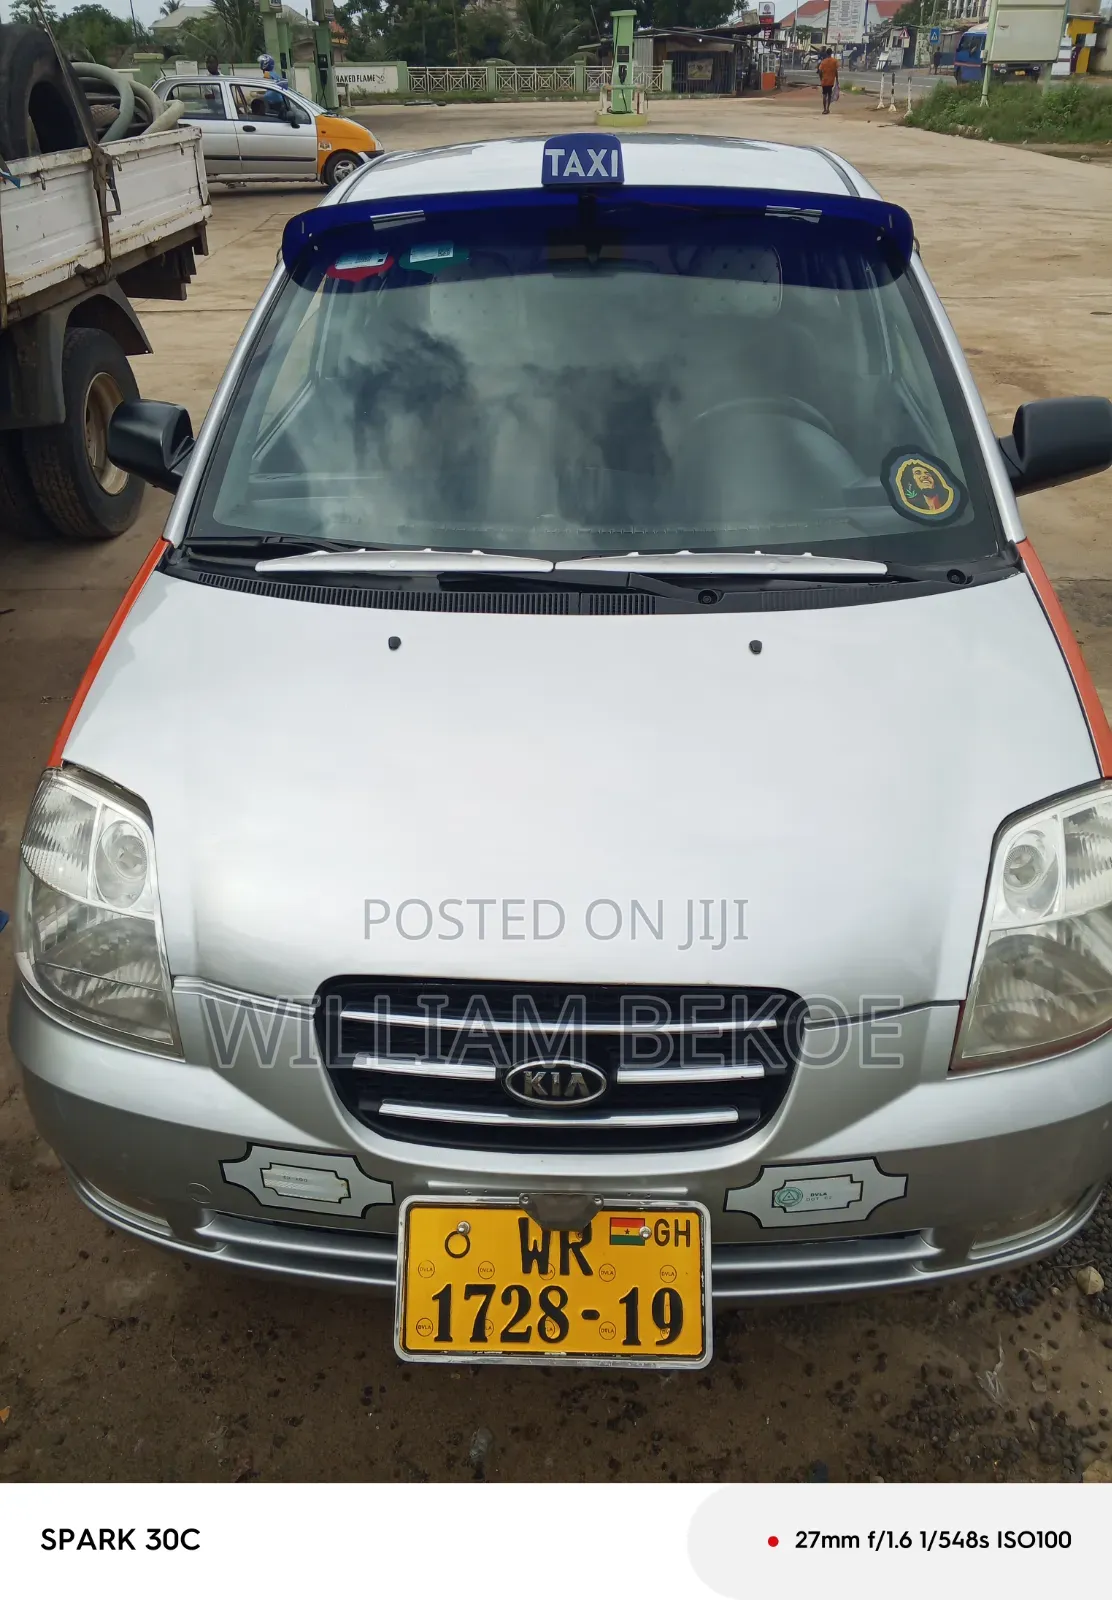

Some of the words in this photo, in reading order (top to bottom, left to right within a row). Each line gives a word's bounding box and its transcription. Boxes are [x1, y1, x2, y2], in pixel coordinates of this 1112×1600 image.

[357, 74, 375, 82] FLAME
[544, 148, 619, 178] TAXI
[522, 1070, 591, 1097] KIA
[518, 1216, 594, 1277] WR
[653, 1218, 691, 1248] GH
